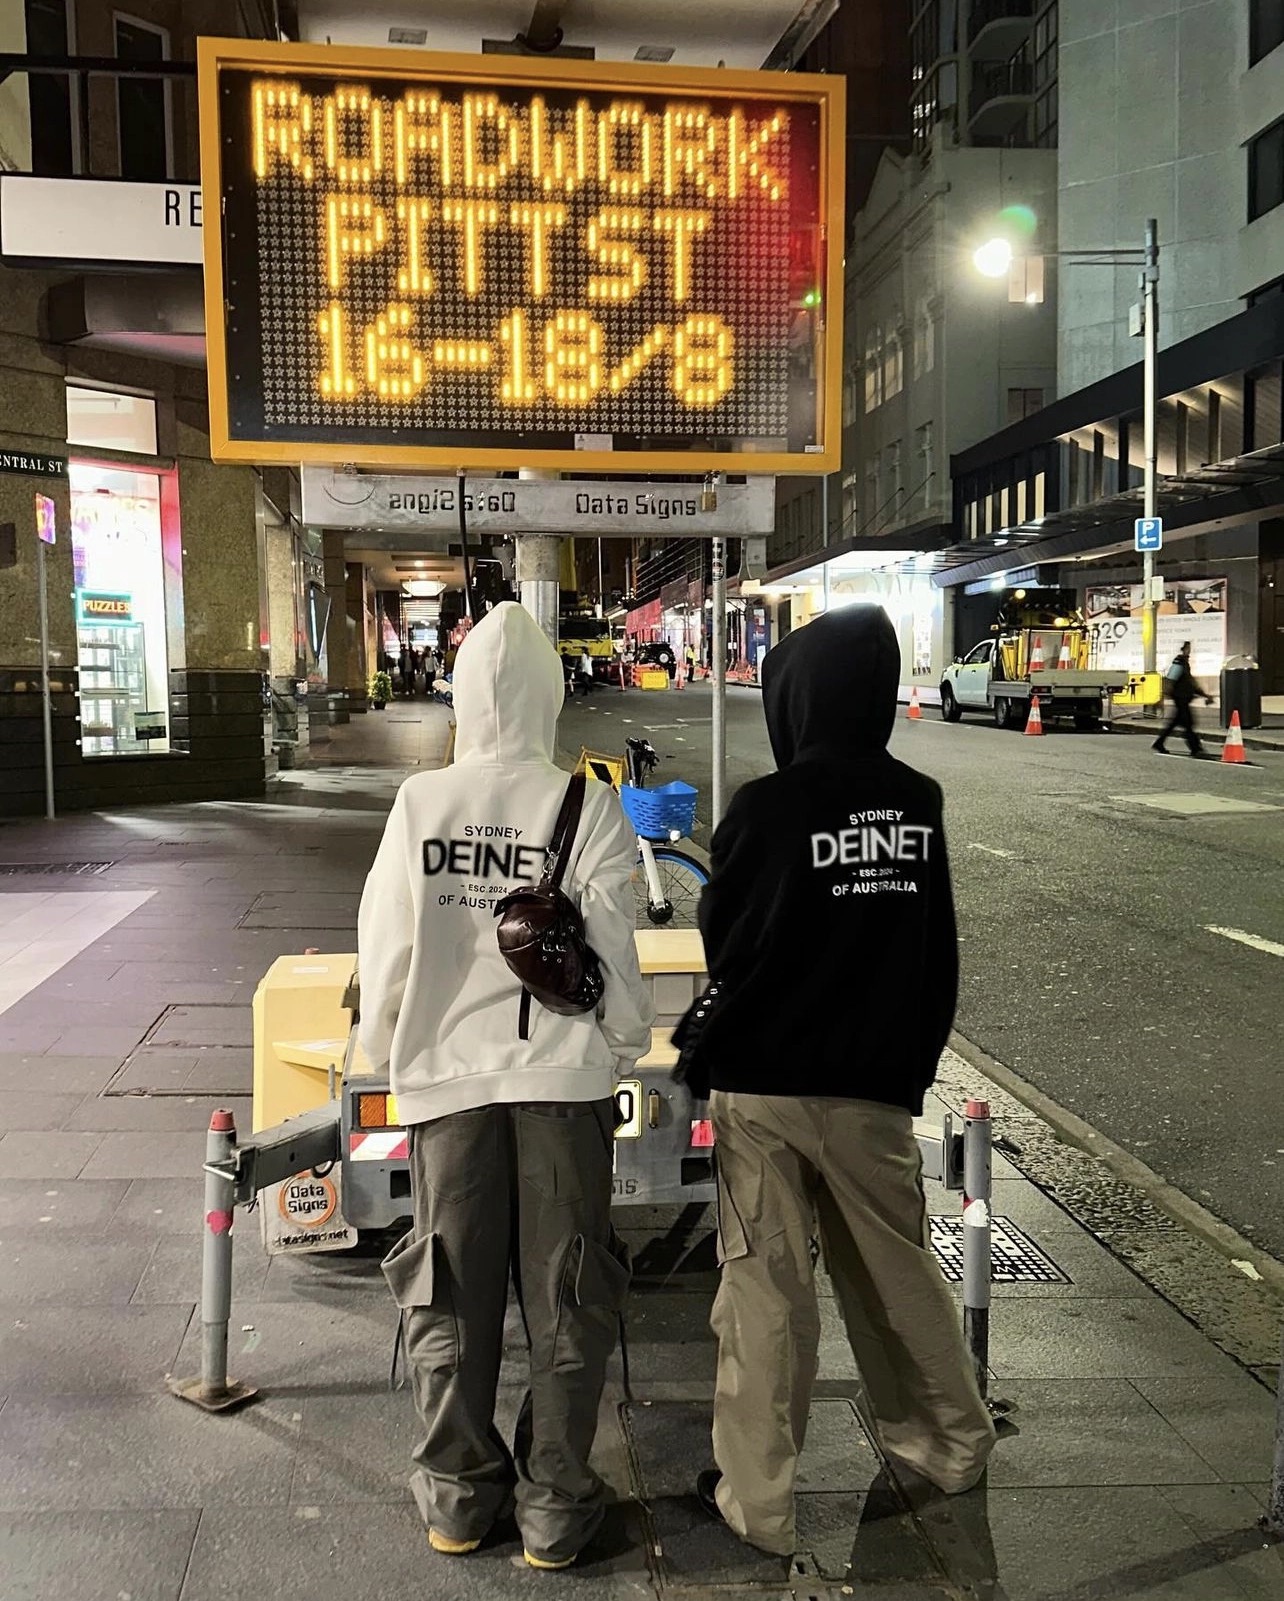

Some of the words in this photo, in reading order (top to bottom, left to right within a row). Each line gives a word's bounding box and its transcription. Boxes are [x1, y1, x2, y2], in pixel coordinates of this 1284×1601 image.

[252, 83, 788, 200] ROADWORK
[318, 303, 733, 406] 16-18/8
[48, 460, 63, 473] ST
[576, 493, 628, 514] Data
[636, 494, 696, 519] Signs
[1142, 521, 1155, 535] P
[849, 809, 904, 825] SYDNEY
[464, 825, 523, 840] SYDNEY
[811, 824, 934, 868] DEINET
[832, 883, 850, 897] OF
[852, 880, 918, 894] AUSTRALIA
[438, 894, 456, 906] OF
[290, 1184, 325, 1199] Data
[288, 1199, 328, 1214] Signs
